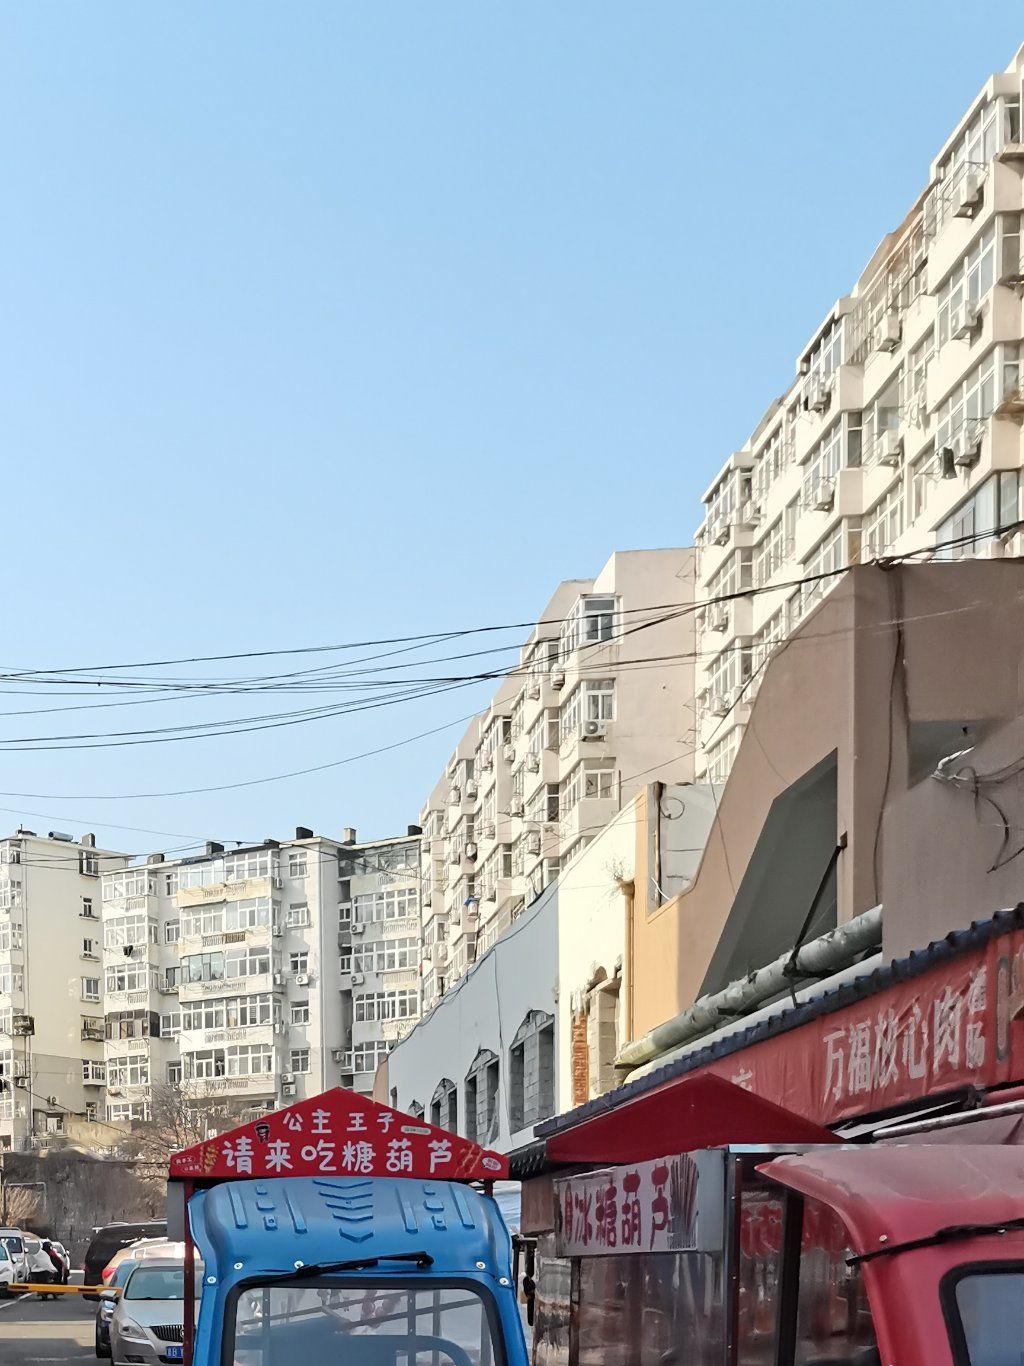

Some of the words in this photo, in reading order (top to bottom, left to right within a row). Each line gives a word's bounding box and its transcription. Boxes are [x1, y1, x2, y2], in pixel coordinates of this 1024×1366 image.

[282, 1109, 395, 1135] 公主王子
[222, 1138, 453, 1174] 请来吃糖葫芦
